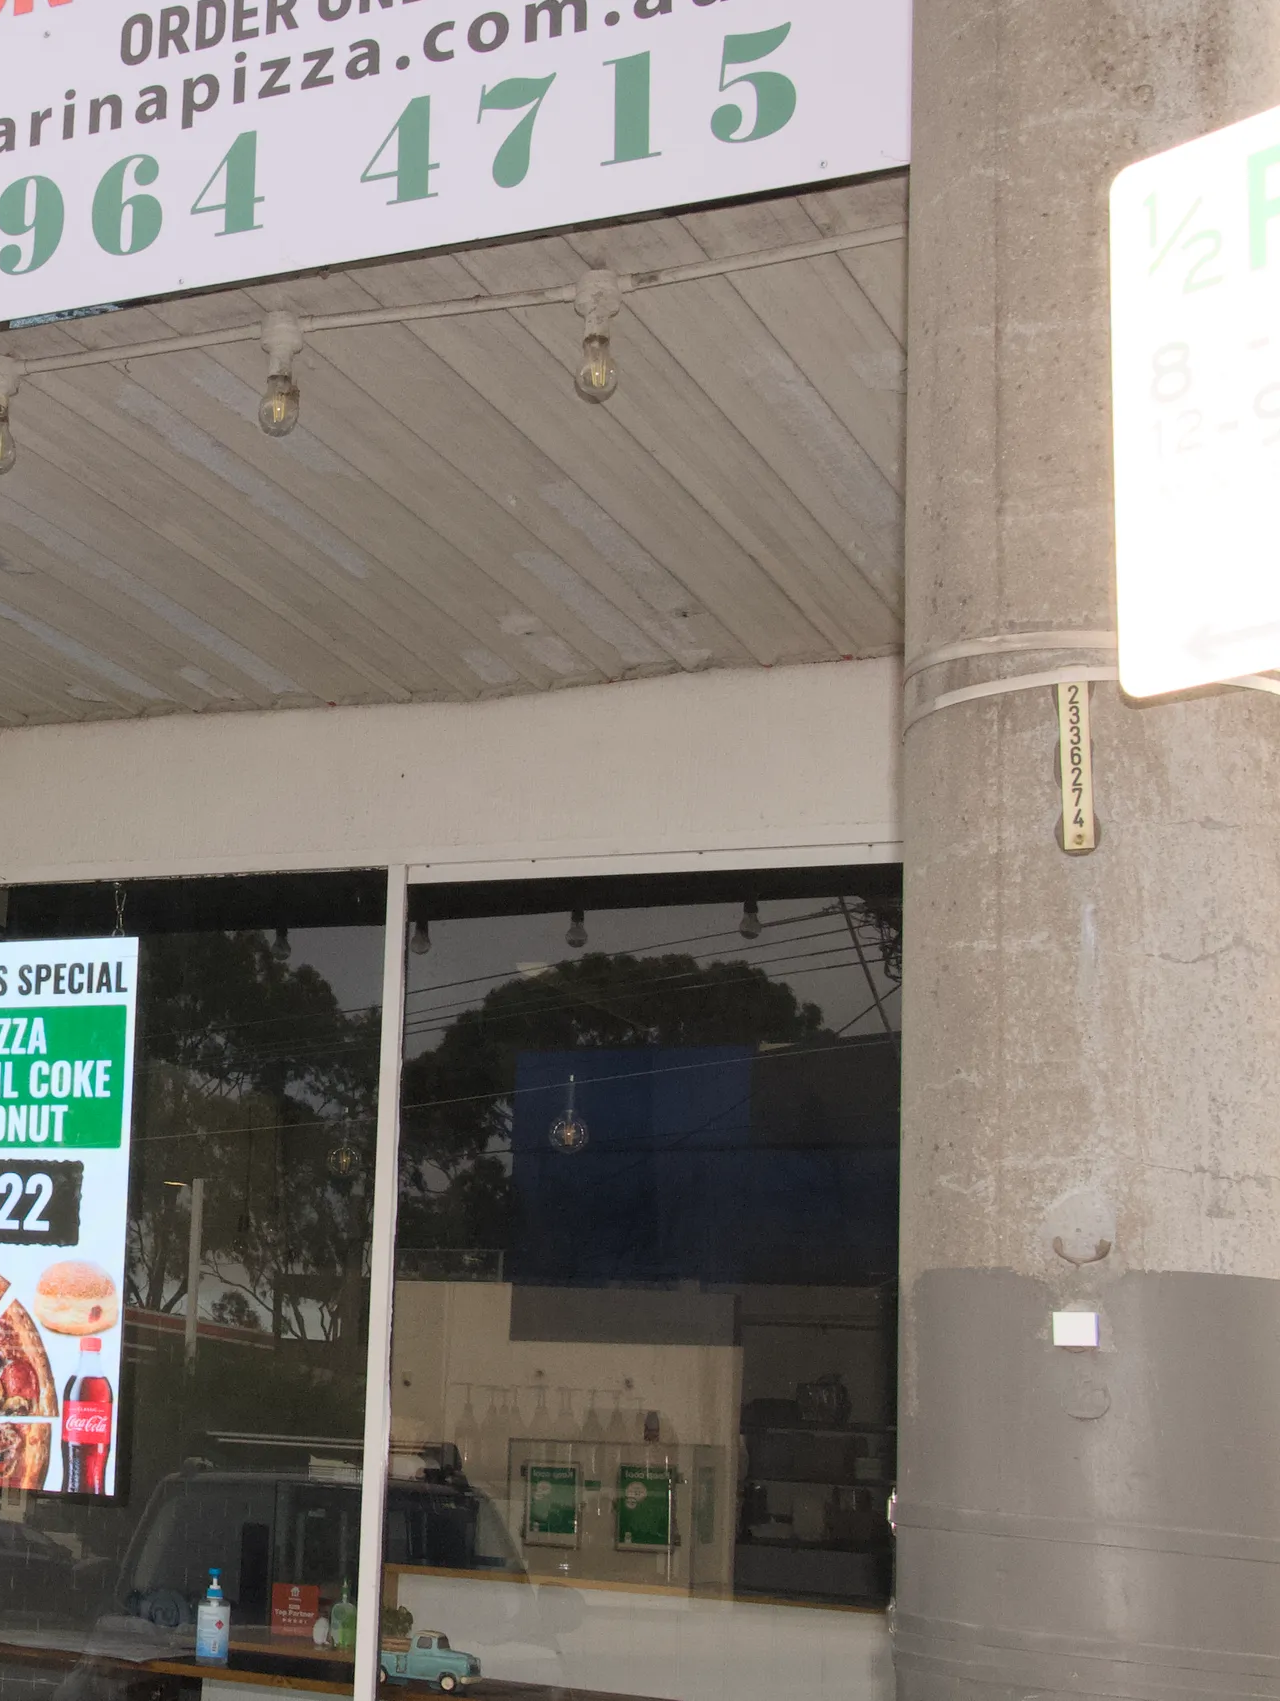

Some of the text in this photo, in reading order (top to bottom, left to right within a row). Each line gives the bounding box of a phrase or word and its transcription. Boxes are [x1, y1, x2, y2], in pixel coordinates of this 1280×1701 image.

[119, 0, 299, 66] ORDER
[359, 22, 797, 205] 4715
[1067, 685, 1085, 829] 2336274
[18, 961, 129, 996] SPECIAL
[29, 1060, 112, 1098] COKE
[274, 1608, 315, 1618] Top Partner
